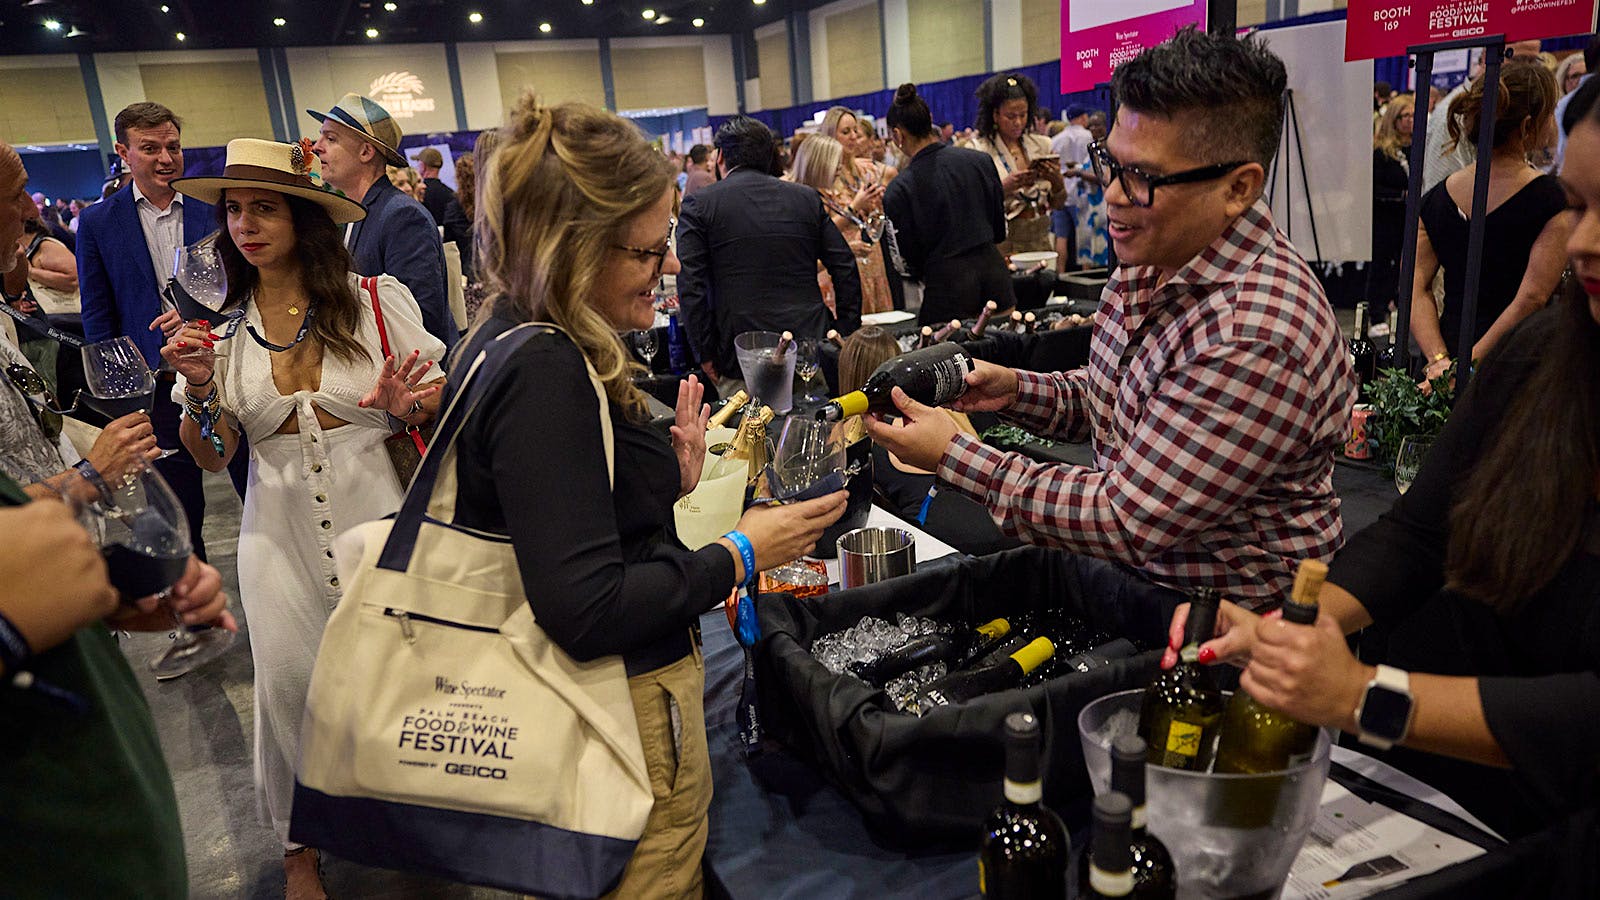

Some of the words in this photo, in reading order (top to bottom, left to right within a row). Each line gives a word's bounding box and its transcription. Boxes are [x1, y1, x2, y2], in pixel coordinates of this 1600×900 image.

[1374, 6, 1411, 21] BOOTH
[1429, 12, 1488, 30] FESTIVAL
[1384, 20, 1399, 31] 169
[1452, 26, 1485, 38] GEICO
[1076, 48, 1099, 61] BOOTH
[1083, 60, 1093, 69] 168
[48, 327, 60, 339] Wine
[59, 332, 82, 347] Spectator
[435, 676, 458, 694] Wine
[459, 680, 506, 699] Spectator
[420, 708, 455, 717] PALM
[462, 712, 508, 723] BEACH
[398, 730, 514, 760] FESTIVAL
[445, 762, 506, 780] GEICO
